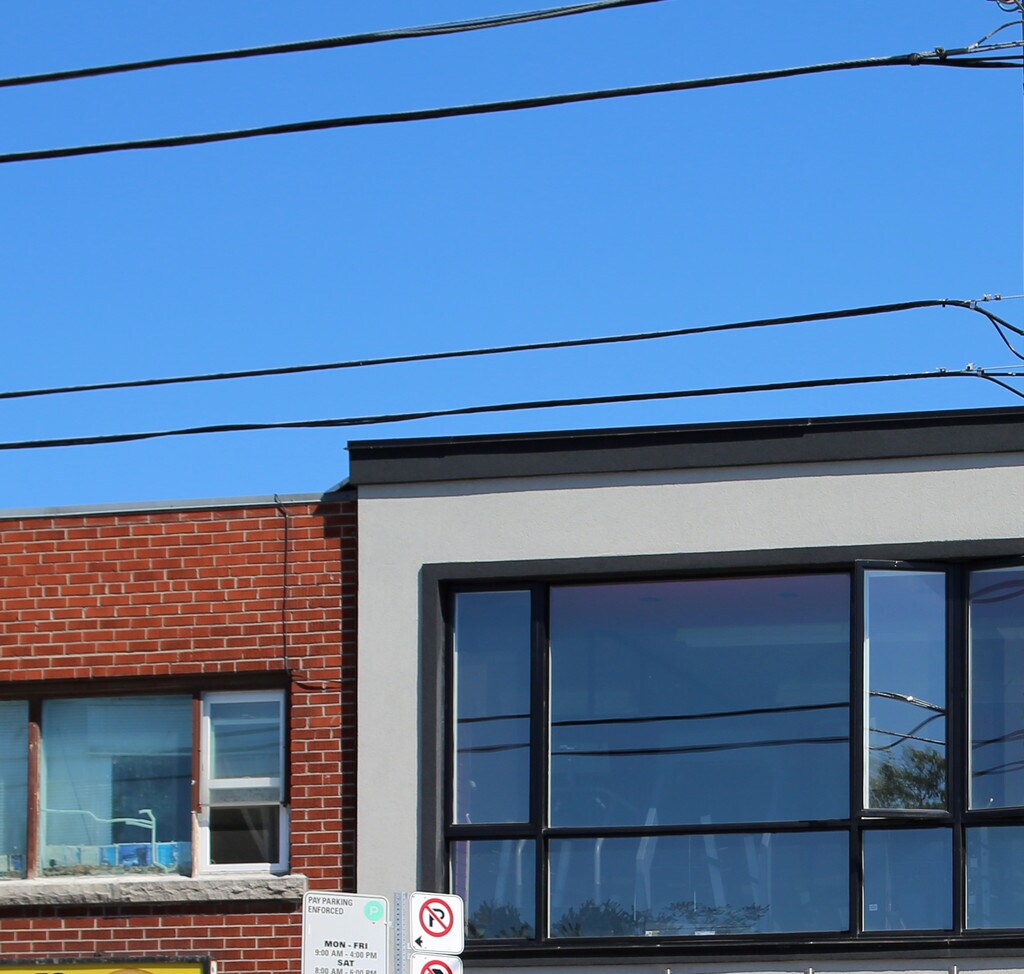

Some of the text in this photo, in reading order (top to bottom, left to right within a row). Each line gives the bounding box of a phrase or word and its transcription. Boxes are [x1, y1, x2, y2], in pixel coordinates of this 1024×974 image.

[322, 897, 353, 906] PARKING
[308, 906, 344, 914] ENFORCED
[324, 940, 346, 948] MON
[315, 949, 329, 957] 9:00
[337, 959, 354, 967] SAT
[314, 967, 329, 974] 8:00
